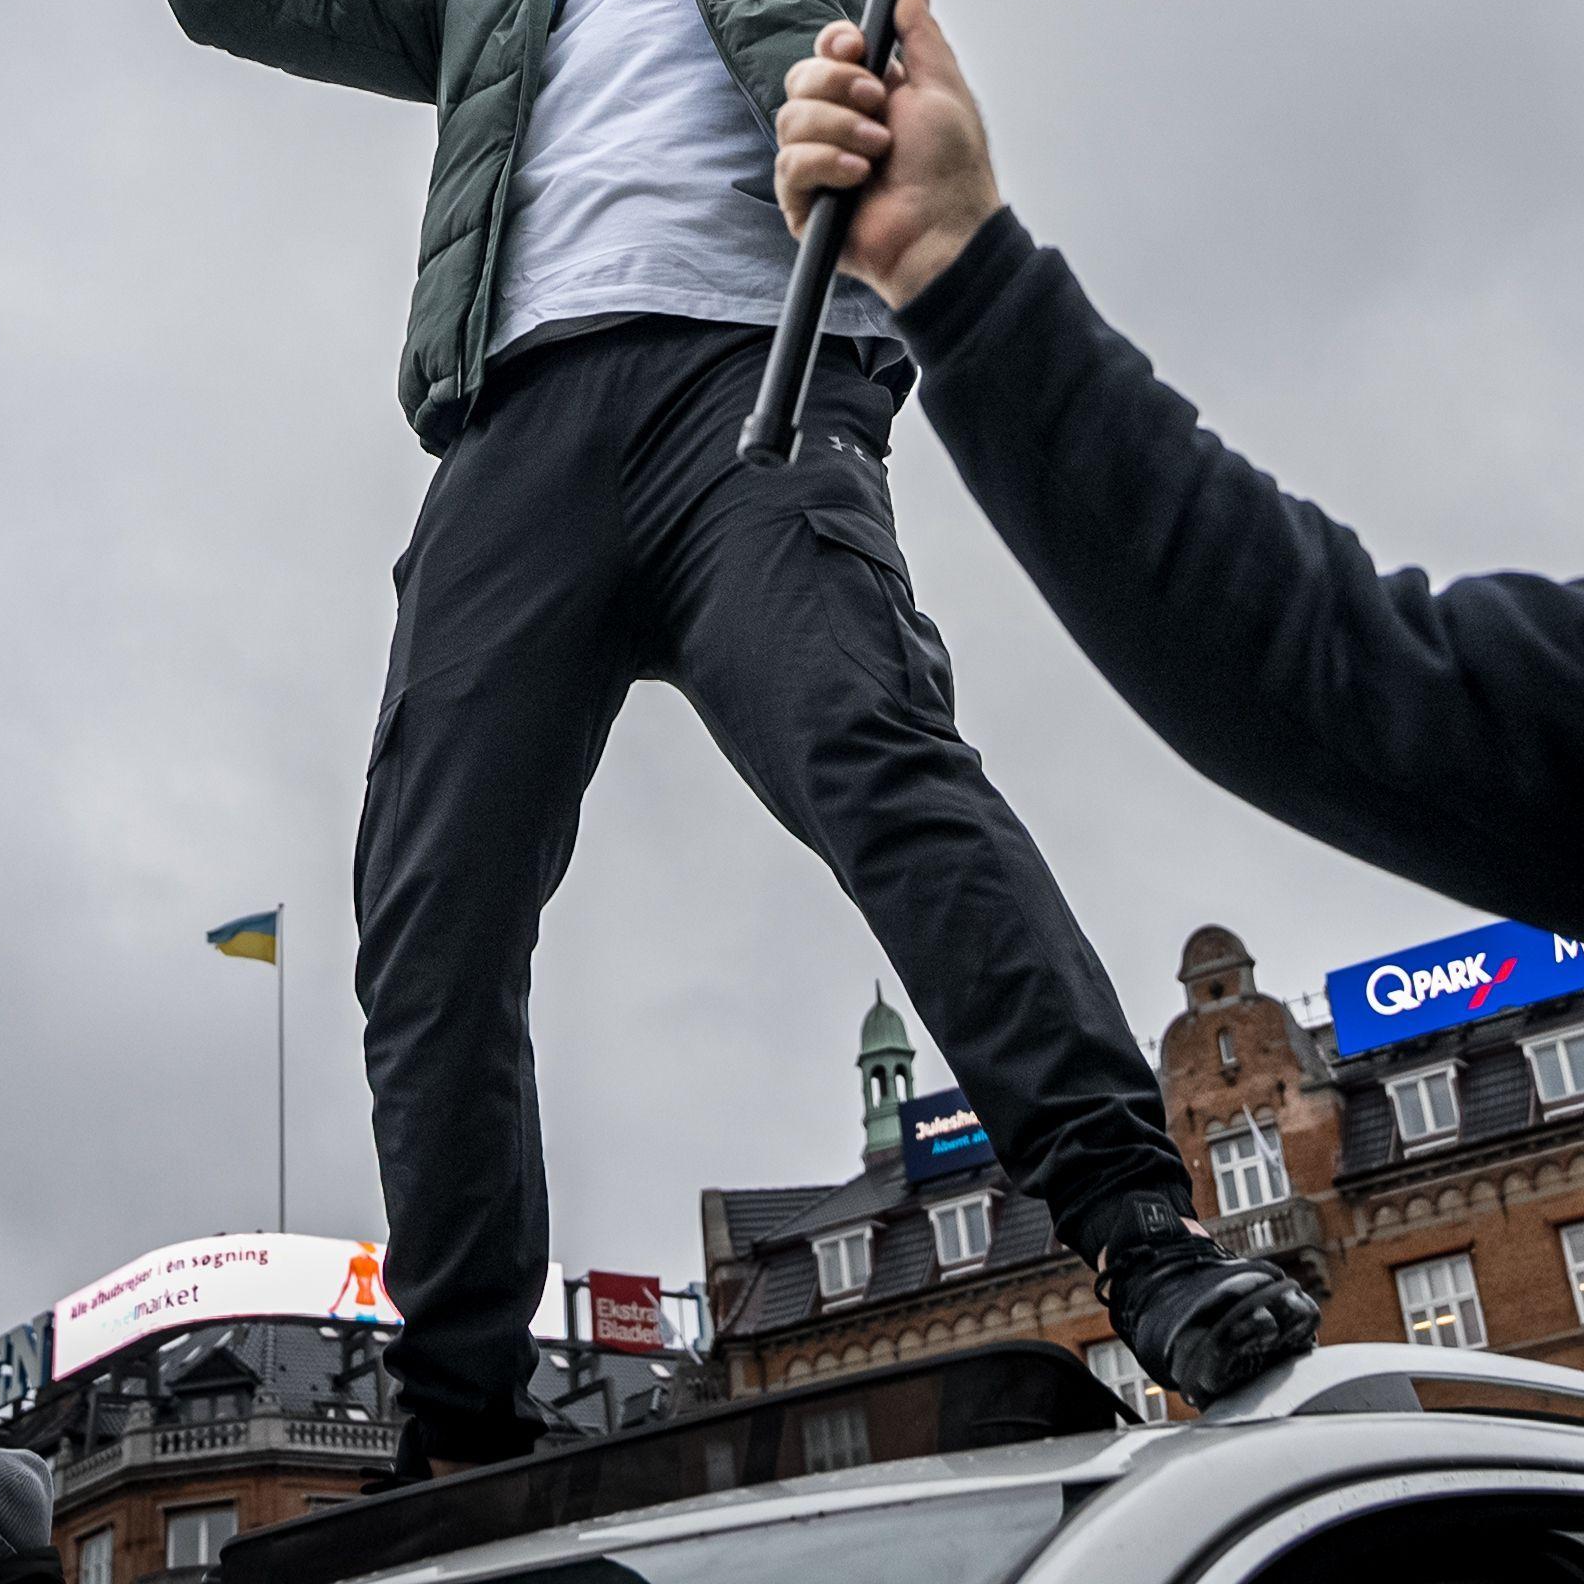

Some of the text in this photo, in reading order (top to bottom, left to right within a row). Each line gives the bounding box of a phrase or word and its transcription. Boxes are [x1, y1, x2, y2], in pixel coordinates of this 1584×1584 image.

[192, 1247, 269, 1269] søgning
[596, 1297, 659, 1323] Ekstra
[597, 1318, 662, 1344] Bladet
